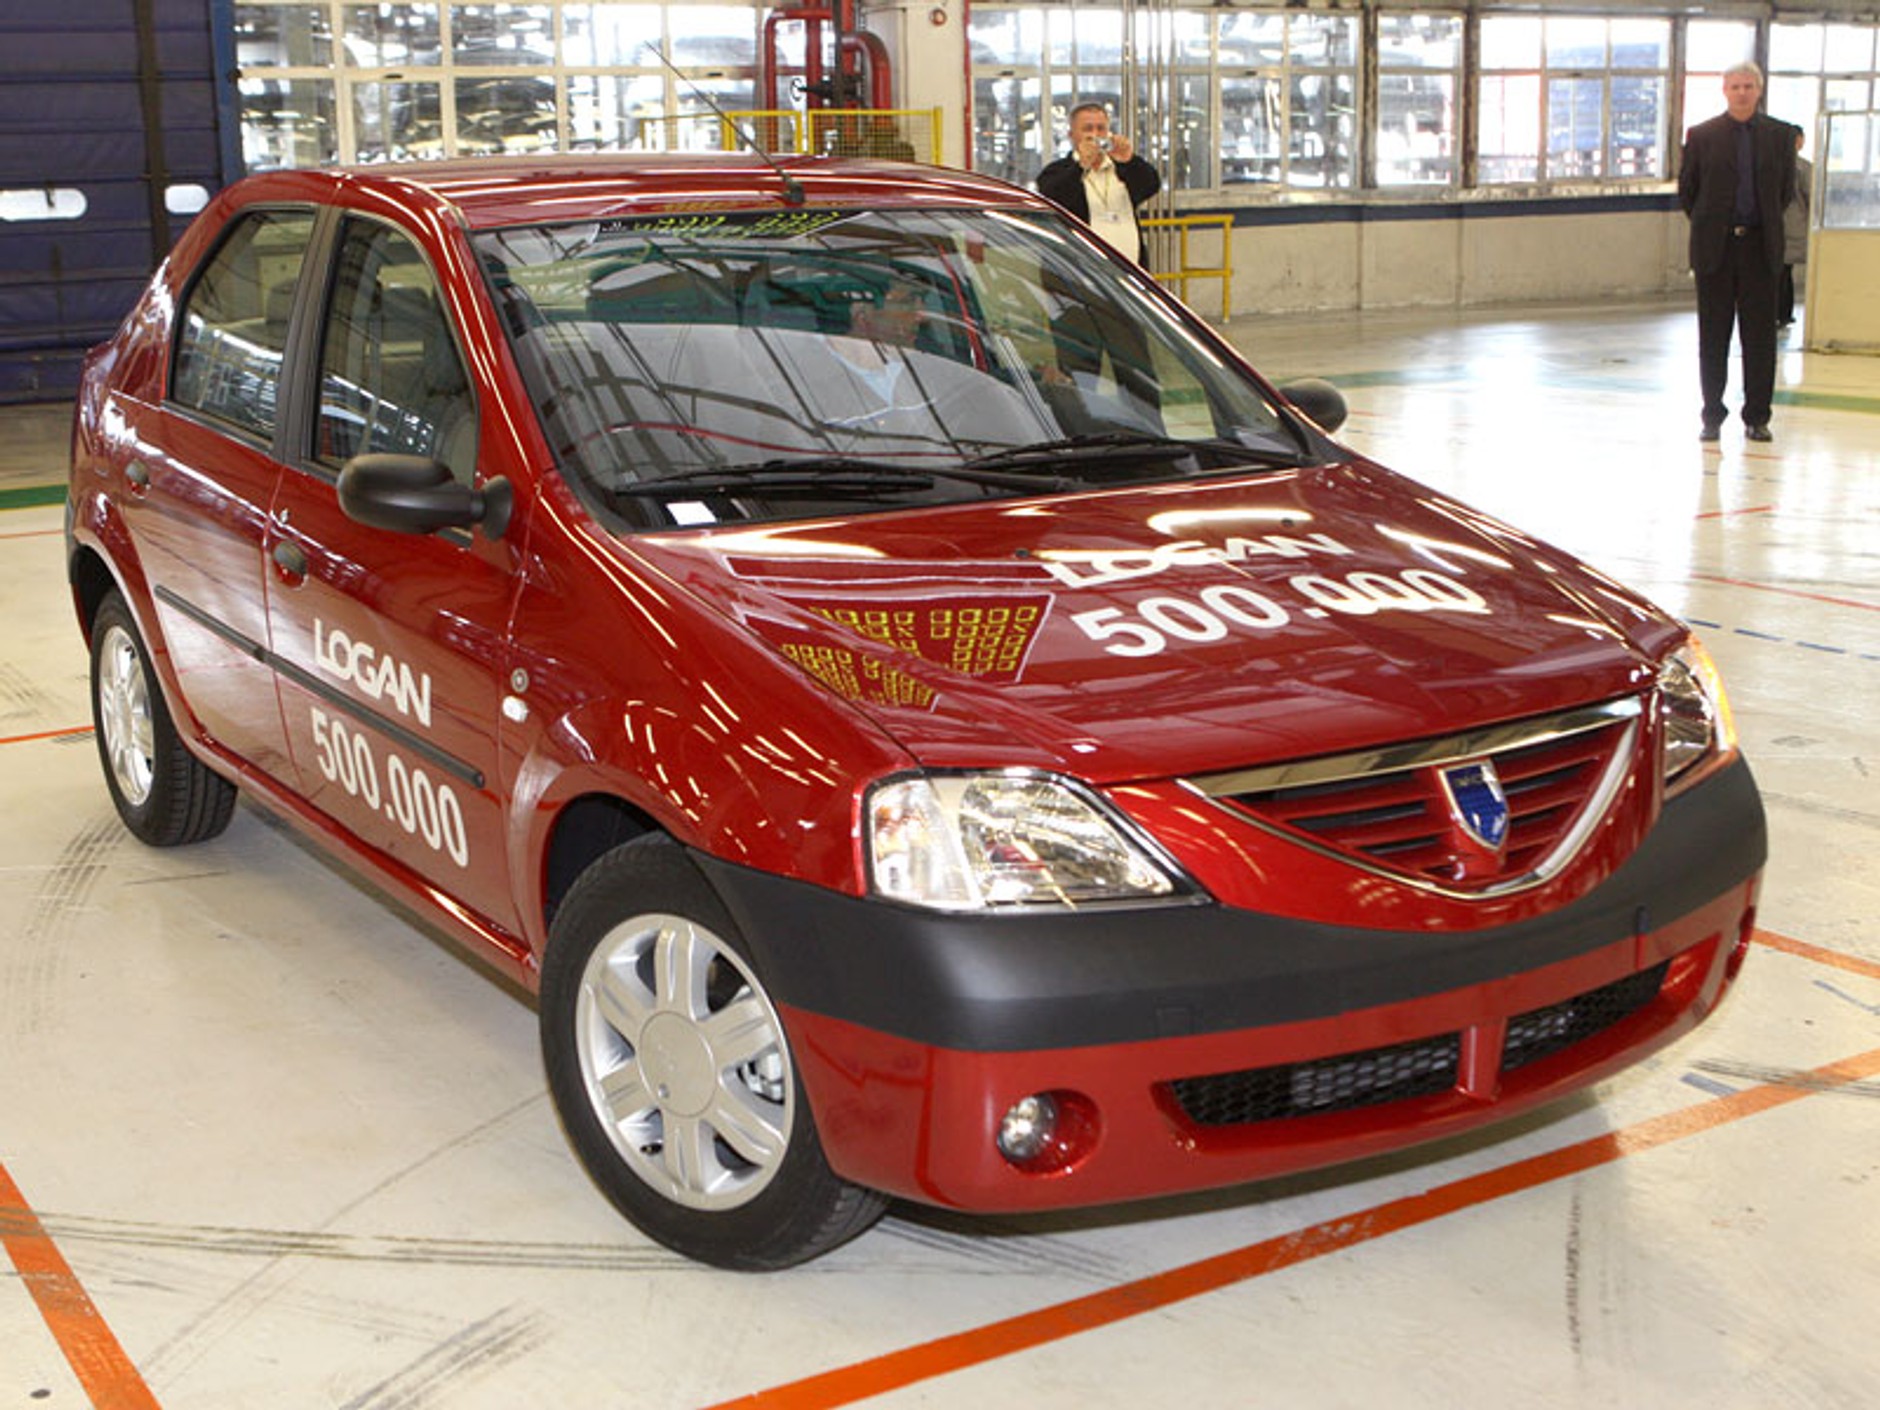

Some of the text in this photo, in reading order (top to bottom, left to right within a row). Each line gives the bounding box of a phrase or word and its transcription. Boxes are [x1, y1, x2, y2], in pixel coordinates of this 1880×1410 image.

[1044, 533, 1354, 589] LOGAN
[1070, 569, 1491, 657] 500.000
[314, 617, 431, 728] LOGAN
[310, 706, 468, 868] 500.000
